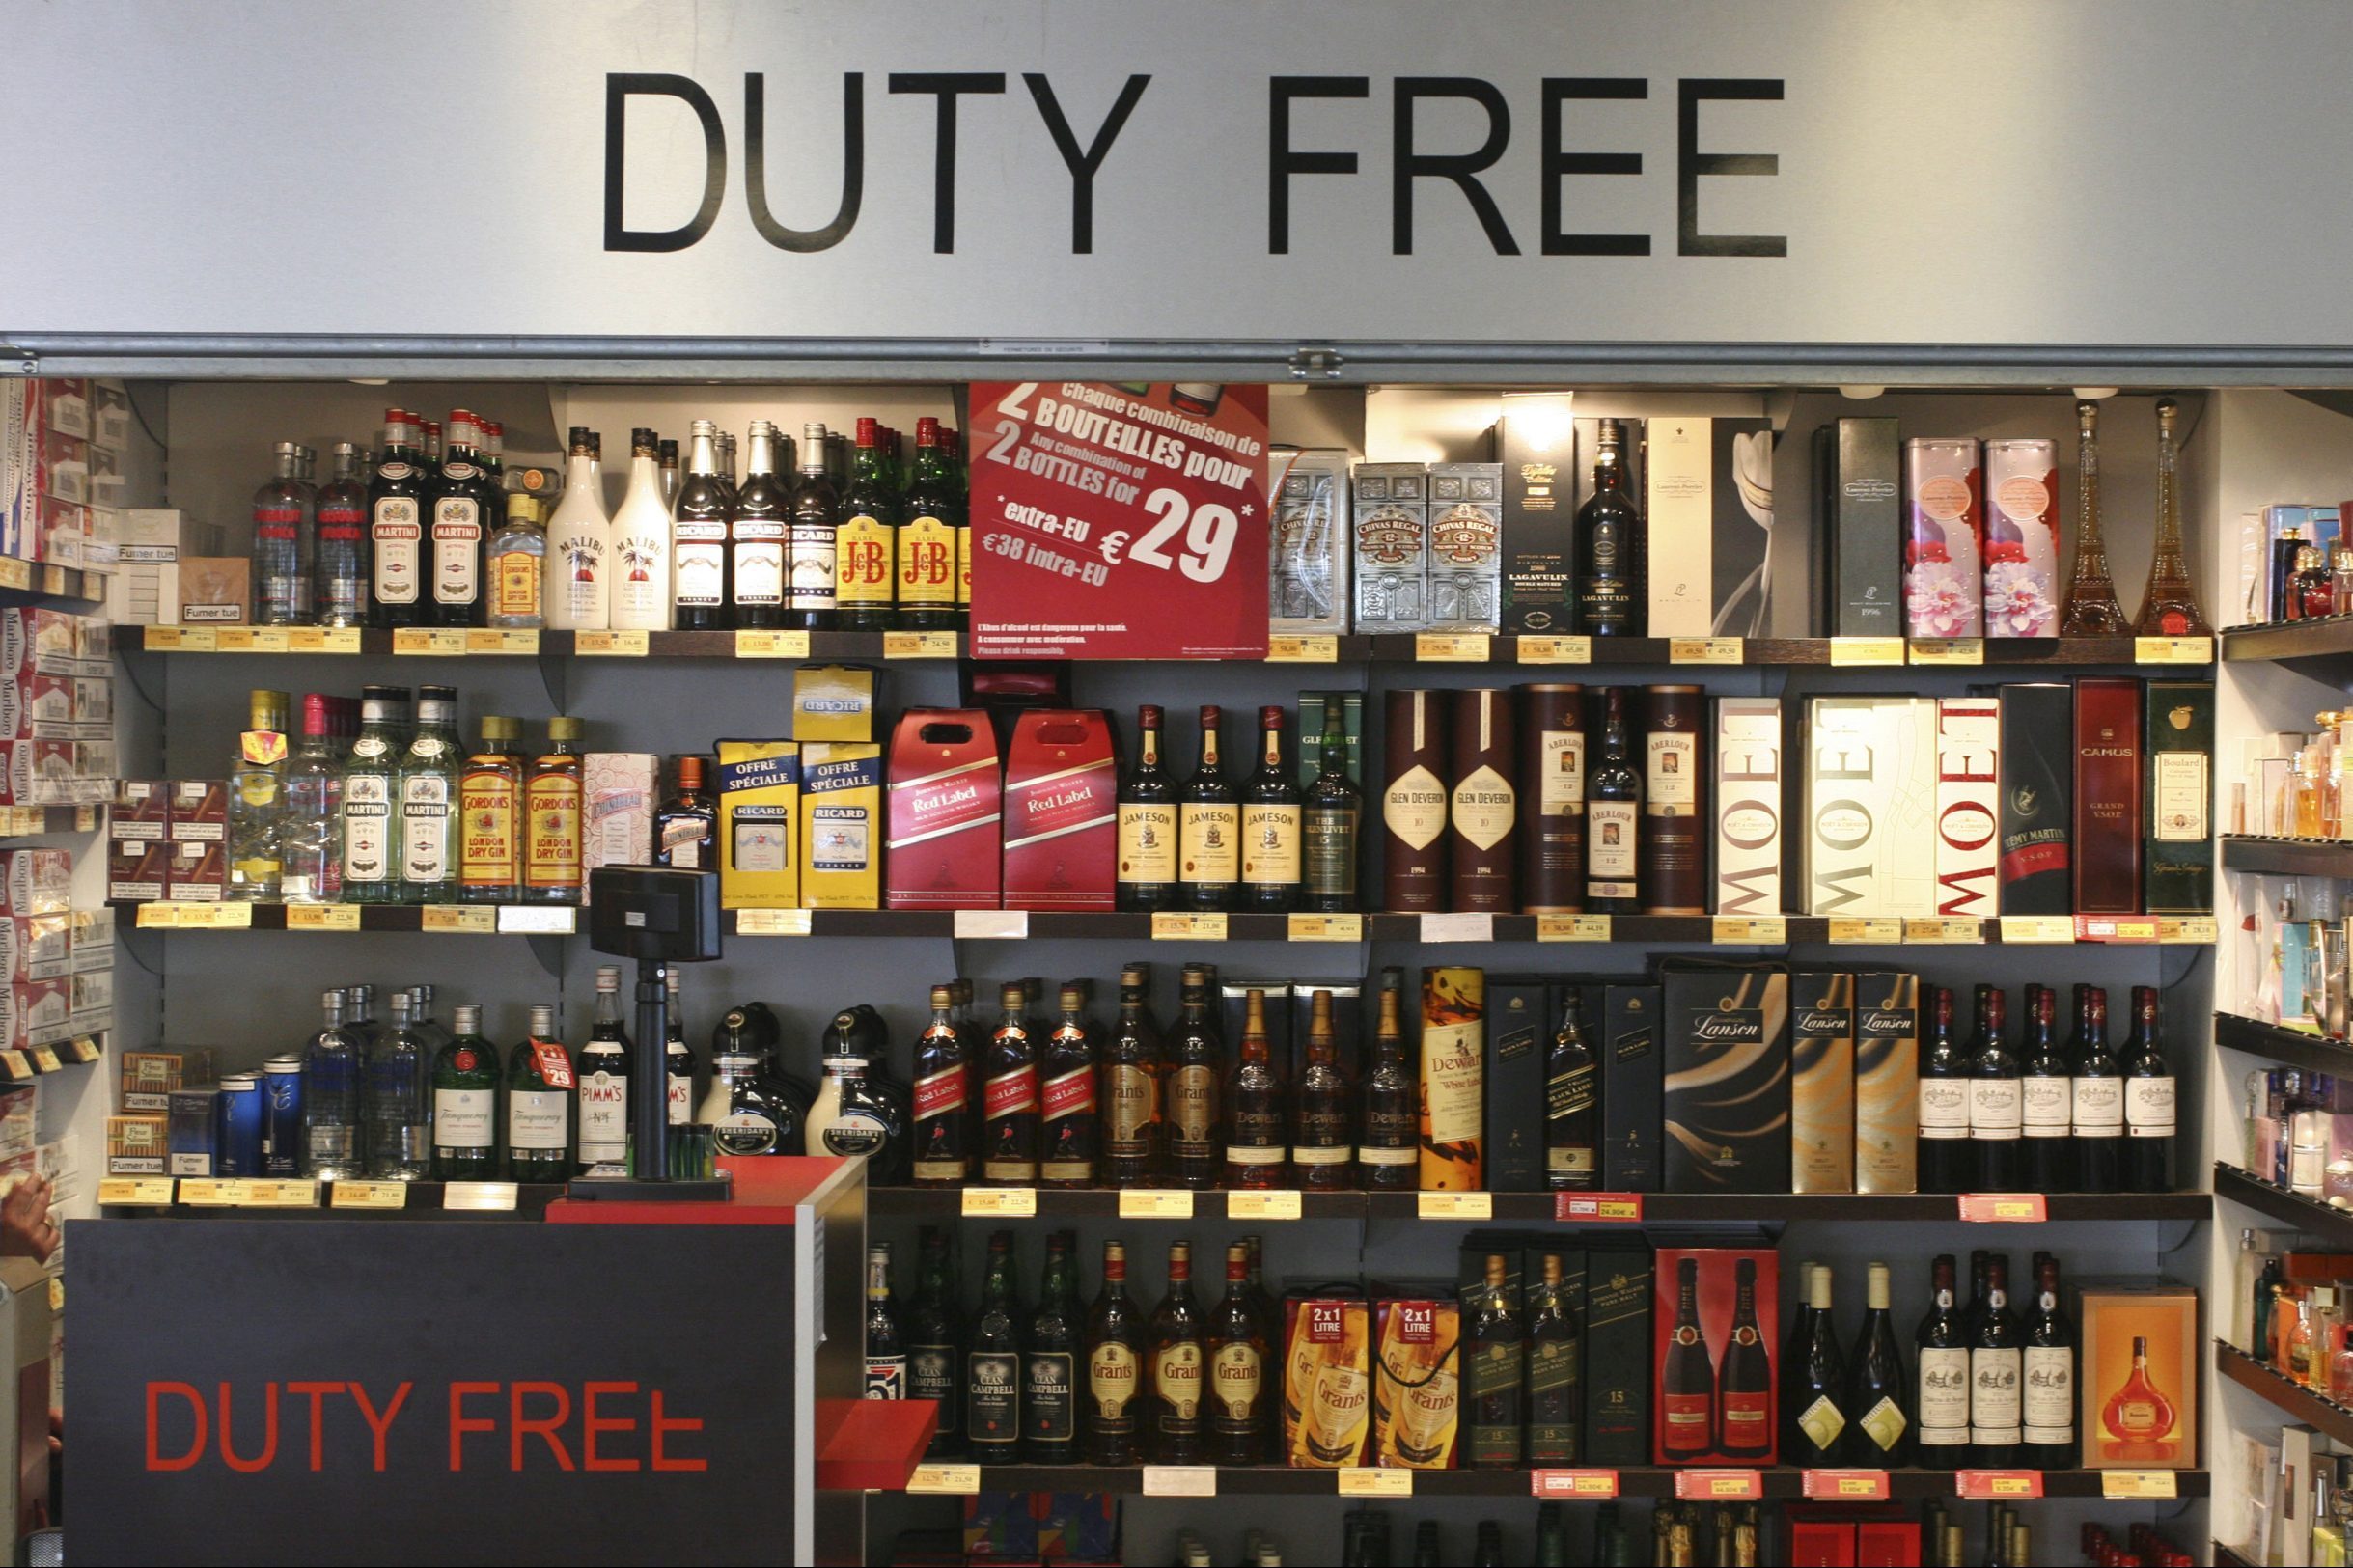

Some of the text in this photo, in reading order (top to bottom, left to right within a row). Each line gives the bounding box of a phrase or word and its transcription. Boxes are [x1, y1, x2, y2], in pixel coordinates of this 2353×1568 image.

[603, 72, 1788, 257] DUTY FREE
[1126, 399, 1236, 450] combinaison
[1236, 436, 1260, 457] de
[997, 382, 1252, 490] 2 BOUTEILLES pour
[986, 420, 1140, 505] 2 BOTTLES for
[1030, 432, 1147, 480] Any combination of
[1004, 501, 1090, 542] extra-EU
[1358, 521, 1421, 534] CHIVAS REGAL
[1432, 521, 1495, 534] CHIVAS REGAL
[376, 527, 417, 537] MARTINI
[436, 527, 477, 537] MARTINI
[559, 536, 606, 556] MALIBU
[616, 536, 663, 556] MALIBU
[119, 548, 175, 559] Fumer tue
[1025, 543, 1109, 587] intra-EU
[185, 607, 238, 618] Fumer tue
[6, 613, 18, 670] Marlboro
[3, 679, 14, 736] Marlboro
[805, 701, 861, 712] RICARD
[1651, 739, 1690, 752] ABERLOUR
[2081, 748, 2133, 756] CAMUS
[735, 759, 777, 775] OFFRE
[817, 761, 859, 776] OFFRE
[2163, 758, 2200, 767] Boulard
[16, 744, 26, 802] Marlboro
[729, 773, 789, 790] SPÉCIALE
[810, 775, 870, 792] SPÉCIALE
[463, 795, 509, 810] GORDON'S
[531, 795, 577, 811] GORDON'S
[912, 785, 977, 813] Red Label
[1027, 786, 1093, 813] Red Label
[1390, 792, 1410, 804] GLEN
[1457, 792, 1476, 804] GLEN
[346, 804, 385, 814] MARTINI
[405, 805, 447, 815] MARTINI
[737, 807, 785, 815] RICARD
[815, 809, 865, 818] RICARD
[1123, 812, 1171, 826] JAMESON
[1188, 812, 1234, 826] JAMESON
[1247, 812, 1293, 827] JAMESON
[2029, 828, 2065, 840] MARTIN
[468, 838, 505, 847] LONDON
[537, 838, 572, 847] LONDON
[468, 847, 506, 858] DRY GIN
[536, 848, 573, 859] DRY GIN
[15, 855, 26, 912] Marlboro
[1694, 1015, 1758, 1040] Lanson
[1798, 1012, 1847, 1031] Lanson
[1862, 1012, 1912, 1031] Lanson
[582, 1086, 622, 1102] PIMM'S
[935, 1082, 958, 1097] Label
[1005, 1082, 1028, 1097] Label
[1062, 1082, 1087, 1097] Label
[125, 1096, 158, 1106] Fumer
[160, 1096, 169, 1106] tu
[111, 1161, 163, 1170] Fumer tue
[1314, 1322, 1340, 1333] LITRE
[1404, 1323, 1431, 1333] LITRE
[980, 1374, 1004, 1385] CLAN
[1034, 1374, 1057, 1385] CLAN
[971, 1385, 1014, 1395] CAMPBELL
[1318, 1379, 1367, 1409] Grant's
[1610, 1390, 1624, 1403] 15
[145, 1381, 707, 1472] DUTY FREE
